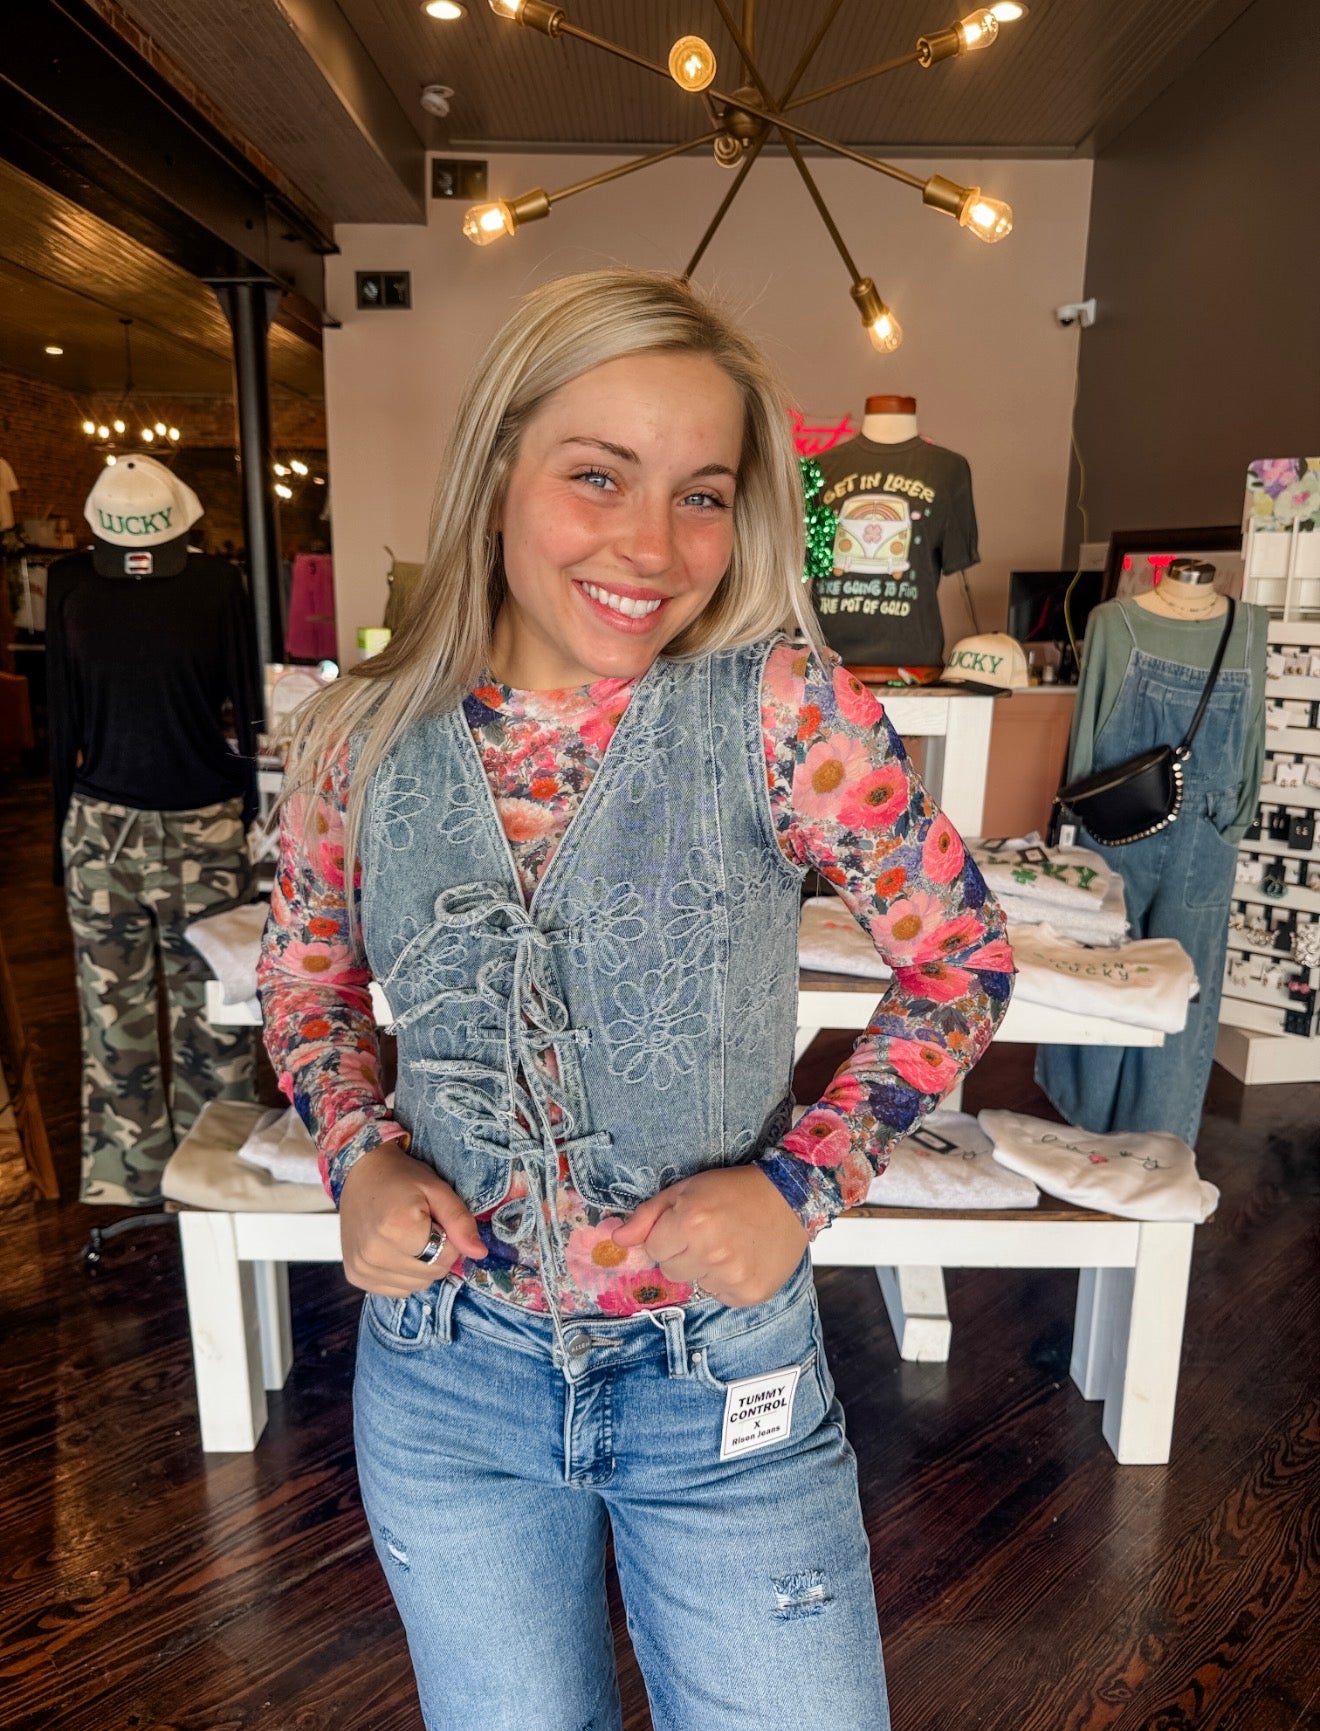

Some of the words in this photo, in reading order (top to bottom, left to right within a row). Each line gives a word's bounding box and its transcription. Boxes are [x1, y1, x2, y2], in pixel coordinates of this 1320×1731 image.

[823, 473, 858, 505] GET
[860, 471, 882, 490] IN
[883, 473, 935, 504] LOSER
[97, 506, 172, 535] LUCKY
[816, 580, 841, 596] E'RE
[842, 579, 882, 597] GOING
[884, 581, 898, 597] TO
[820, 597, 840, 615] THE
[840, 596, 864, 613] POT
[862, 599, 879, 615] OF
[880, 601, 911, 617] GOLD
[948, 650, 1004, 674] UCKY
[739, 1386, 785, 1408] TUMMY
[730, 1398, 788, 1423] CONTROL
